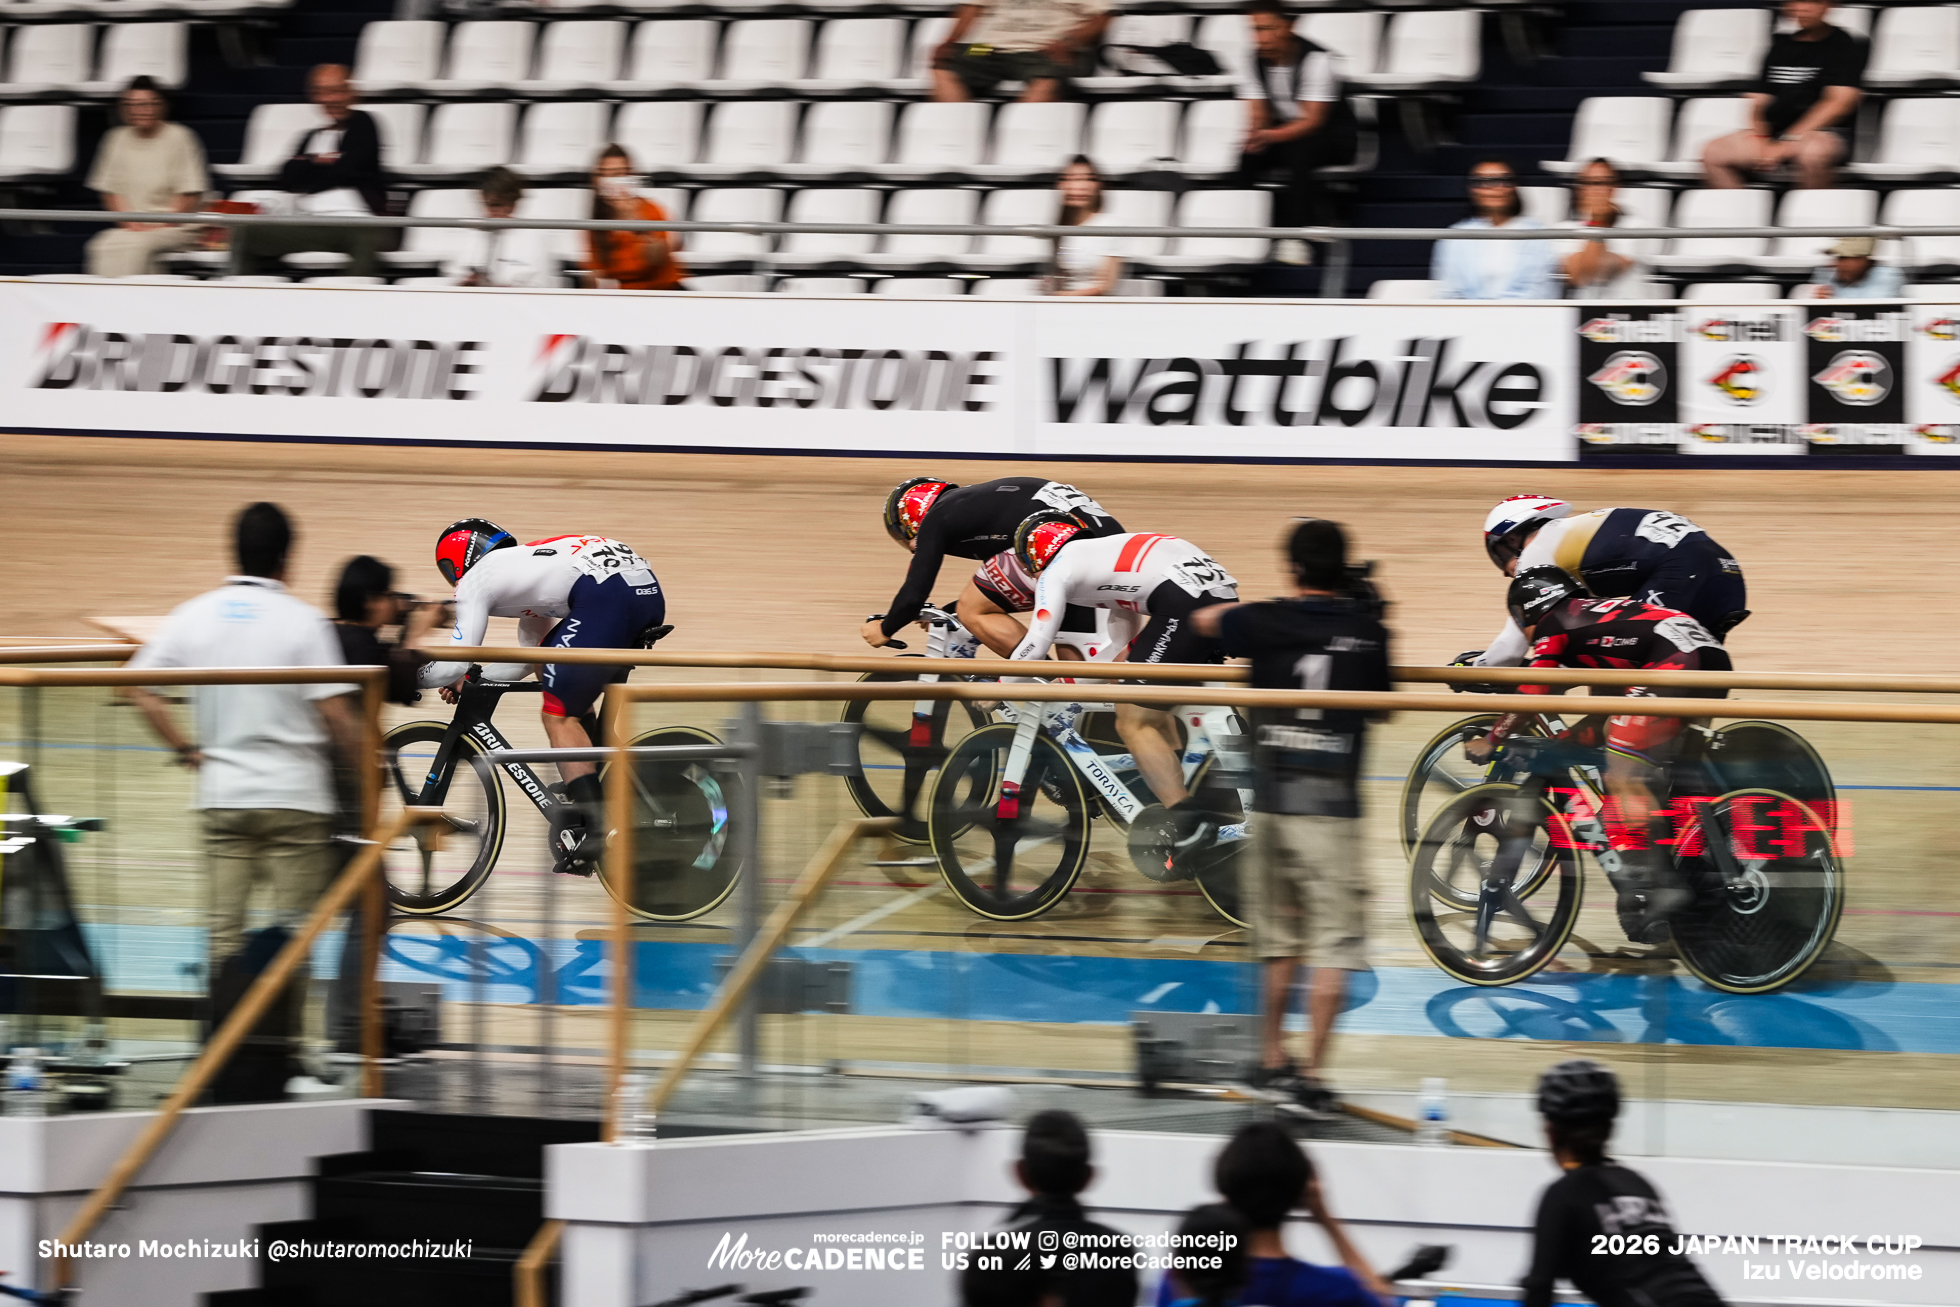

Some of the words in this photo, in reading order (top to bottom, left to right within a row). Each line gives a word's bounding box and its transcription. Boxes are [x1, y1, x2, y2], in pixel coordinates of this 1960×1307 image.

[33, 322, 486, 400] BRIDGESTONE
[532, 334, 1002, 411] BRIDGESTONE
[1044, 335, 1546, 430] wattbike
[464, 531, 478, 567] Kabuto
[1183, 556, 1214, 585] 72
[1291, 653, 1333, 720] 1
[472, 722, 553, 809] BRIESTONE
[1086, 759, 1135, 814] TORAYCA
